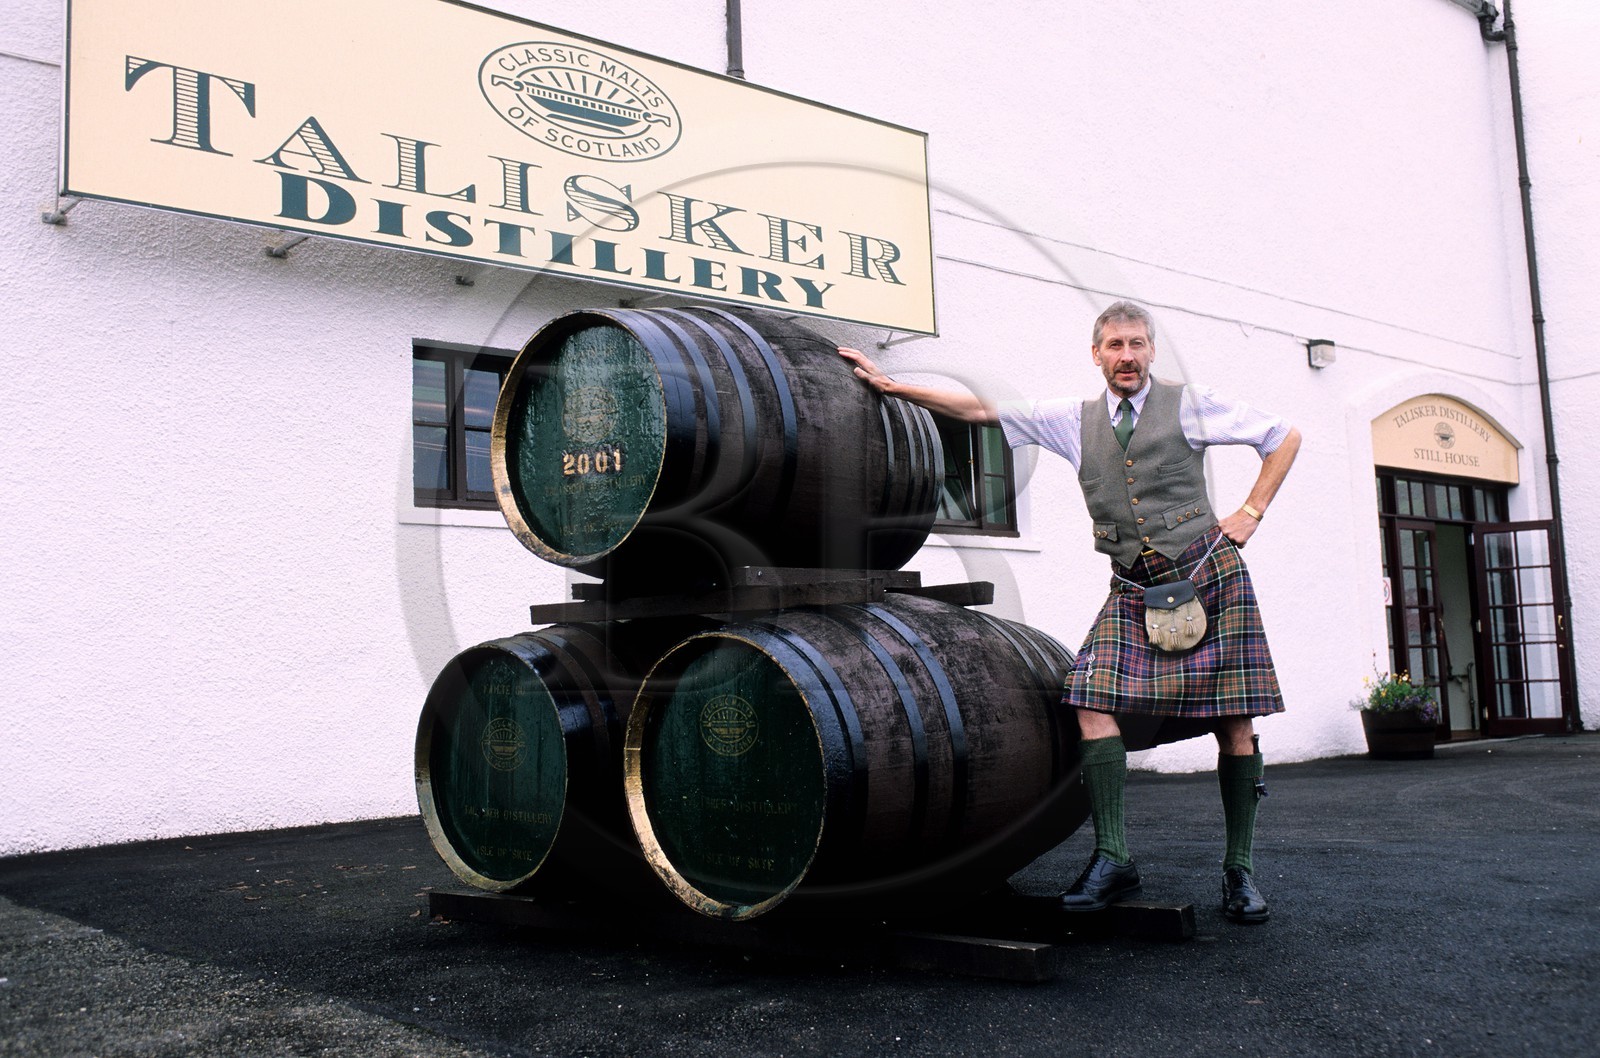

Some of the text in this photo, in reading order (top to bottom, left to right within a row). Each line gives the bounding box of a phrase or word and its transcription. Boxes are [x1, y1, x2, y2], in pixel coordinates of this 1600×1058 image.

[498, 47, 664, 108] CLASSIC MALTS
[508, 106, 661, 158] OF SCOTLAND
[125, 55, 906, 286] TALISKER
[274, 170, 835, 310] DISTILLERY
[1392, 405, 1438, 429] TALISKER
[1439, 406, 1492, 443] DISTILLERY
[562, 448, 622, 476] 2001
[1413, 448, 1480, 467] STILL HOUSE
